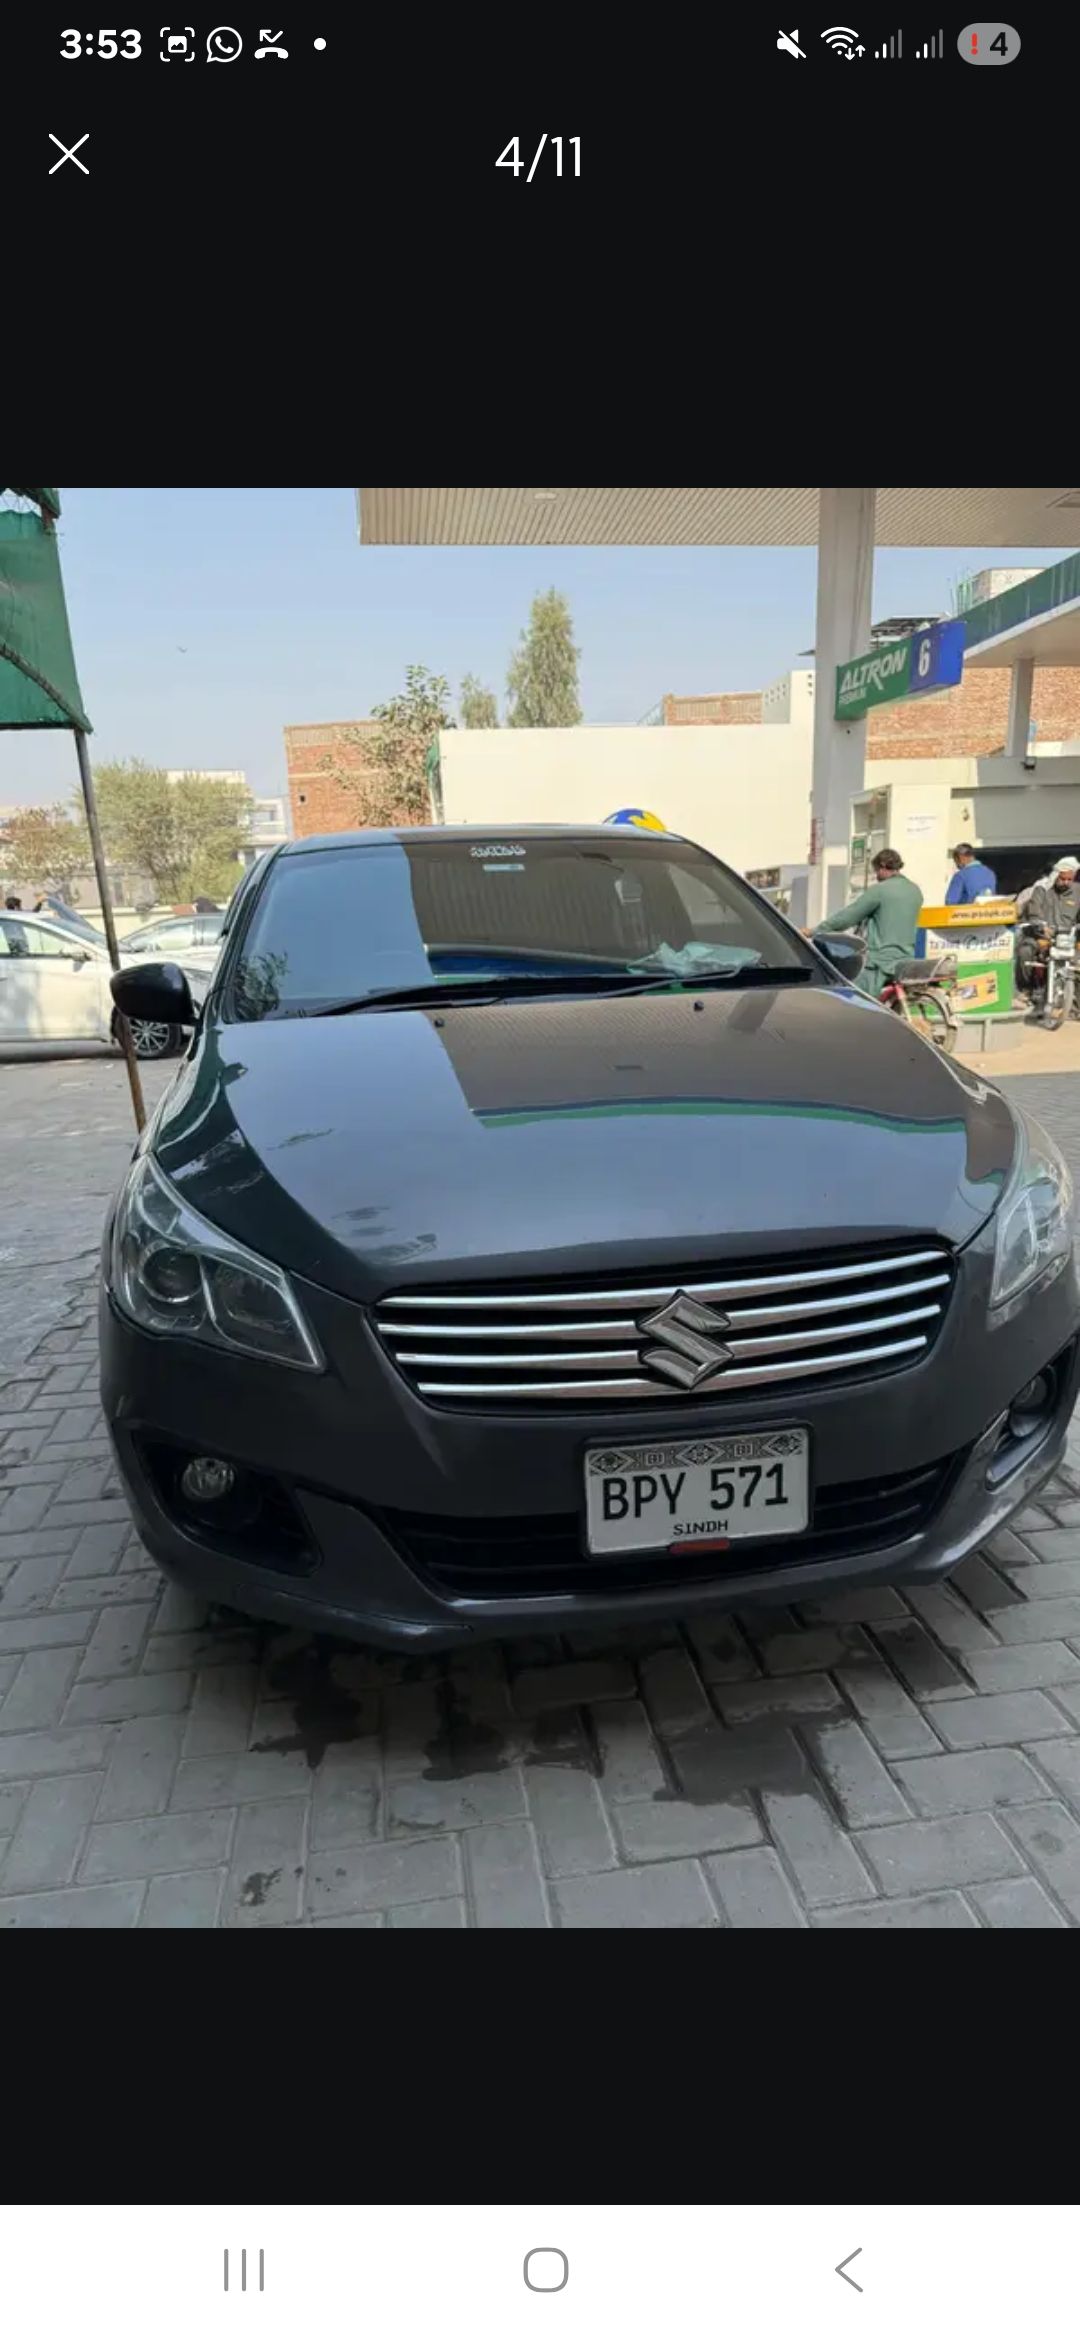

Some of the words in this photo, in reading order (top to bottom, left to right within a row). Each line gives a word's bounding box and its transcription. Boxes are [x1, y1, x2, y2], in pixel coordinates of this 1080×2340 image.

[840, 648, 907, 693] ALTRON
[918, 638, 931, 677] 6
[602, 1472, 687, 1521] BPY
[710, 1463, 788, 1511] 571
[672, 1519, 730, 1536] SINDH
